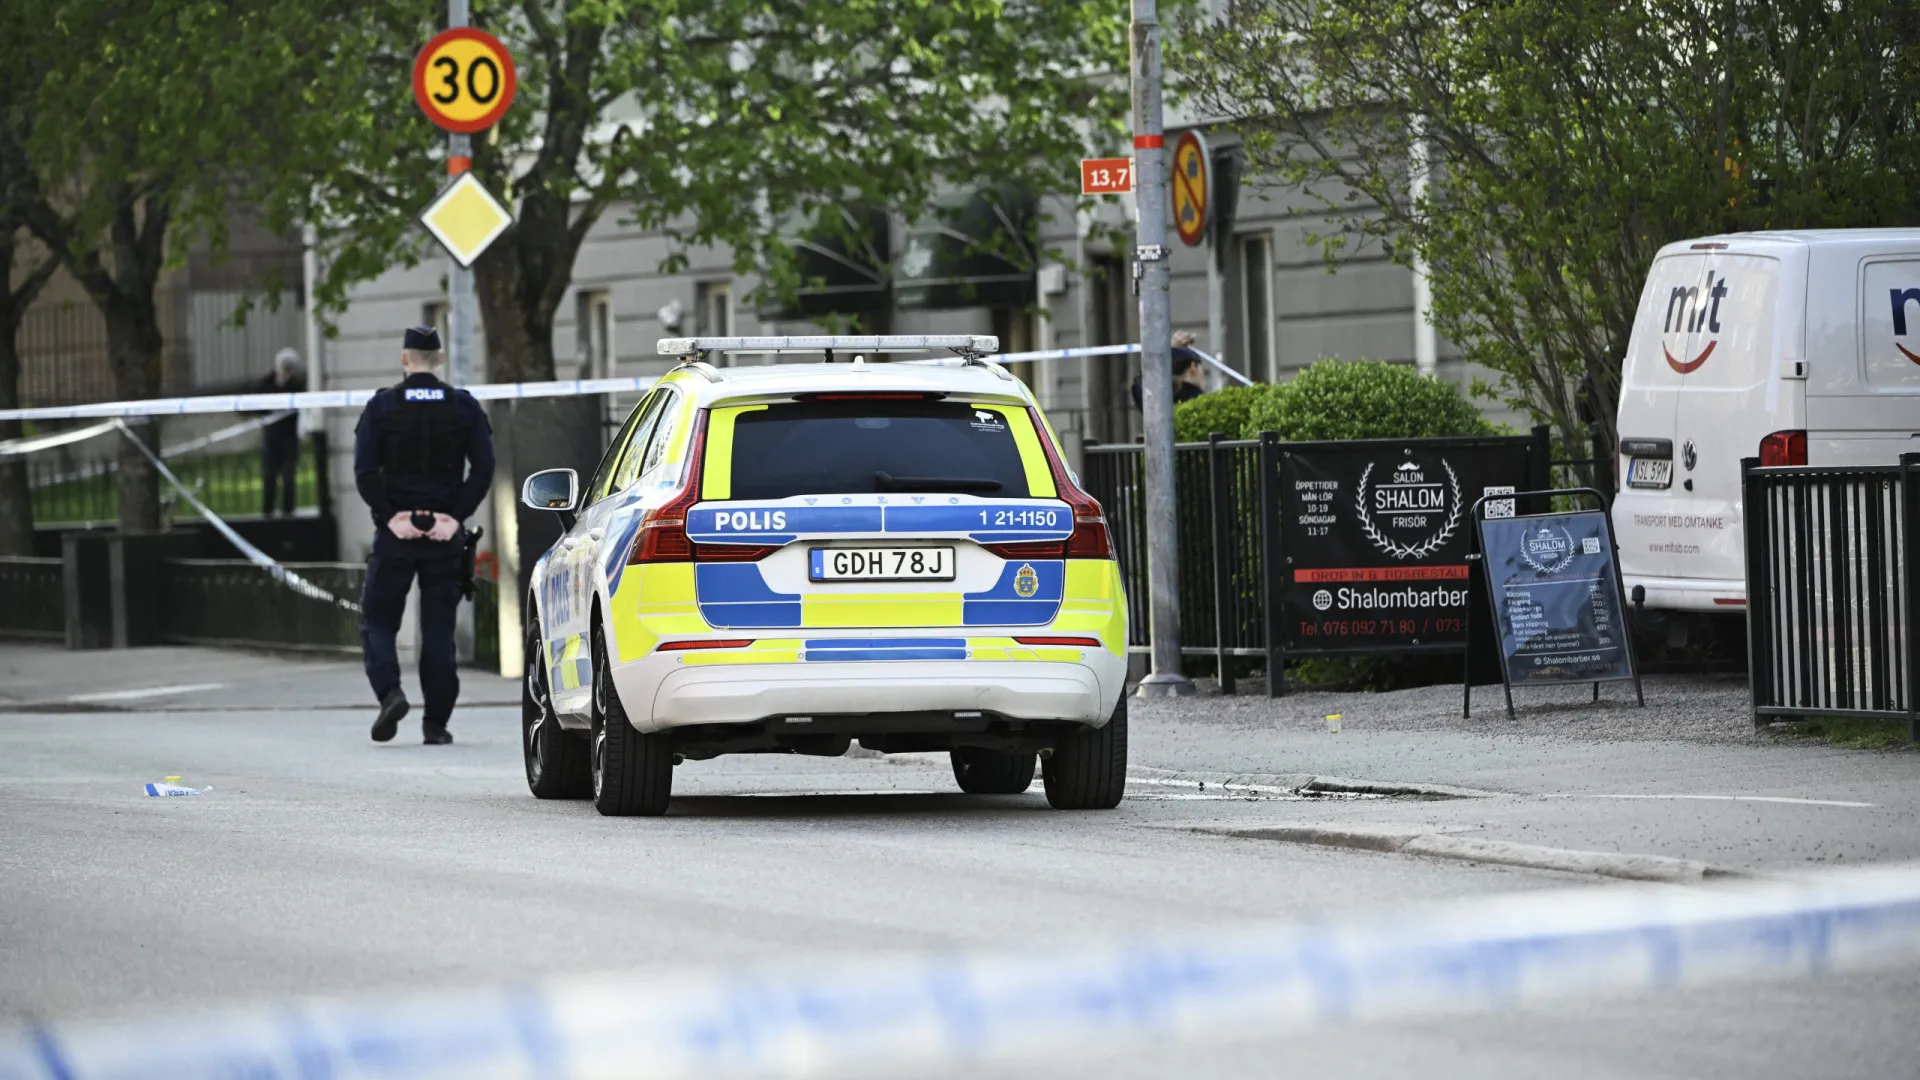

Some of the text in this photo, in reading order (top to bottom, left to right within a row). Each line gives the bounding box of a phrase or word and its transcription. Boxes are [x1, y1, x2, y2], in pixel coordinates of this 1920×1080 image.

[434, 56, 499, 105] 30
[1090, 168, 1128, 188] 13,7
[1664, 270, 1727, 333] mlt
[405, 388, 444, 400] POLIS
[1393, 472, 1423, 483] SALON
[1633, 461, 1669, 481] NSL 59M
[1295, 480, 1338, 491] ÖPPETTIDER
[804, 497, 959, 505] VOLVO
[1375, 489, 1444, 509] SHALOM
[714, 510, 787, 531] POLIS
[979, 509, 1057, 527] 1 21-1150
[1299, 514, 1336, 525] SÖNDAGAR
[1392, 516, 1427, 529] FRISÖR
[1634, 514, 1724, 529] TRANSPORT MED OMTANKE
[1529, 541, 1566, 552] SHALOM
[834, 551, 942, 575] GDH 78J
[1311, 571, 1348, 581] DROP
[1352, 570, 1364, 580] IN
[1337, 585, 1468, 610] Shalombarber
[1324, 619, 1349, 635] 076
[1352, 621, 1376, 634] 092
[1380, 620, 1396, 634] 71
[1399, 619, 1415, 634] 80
